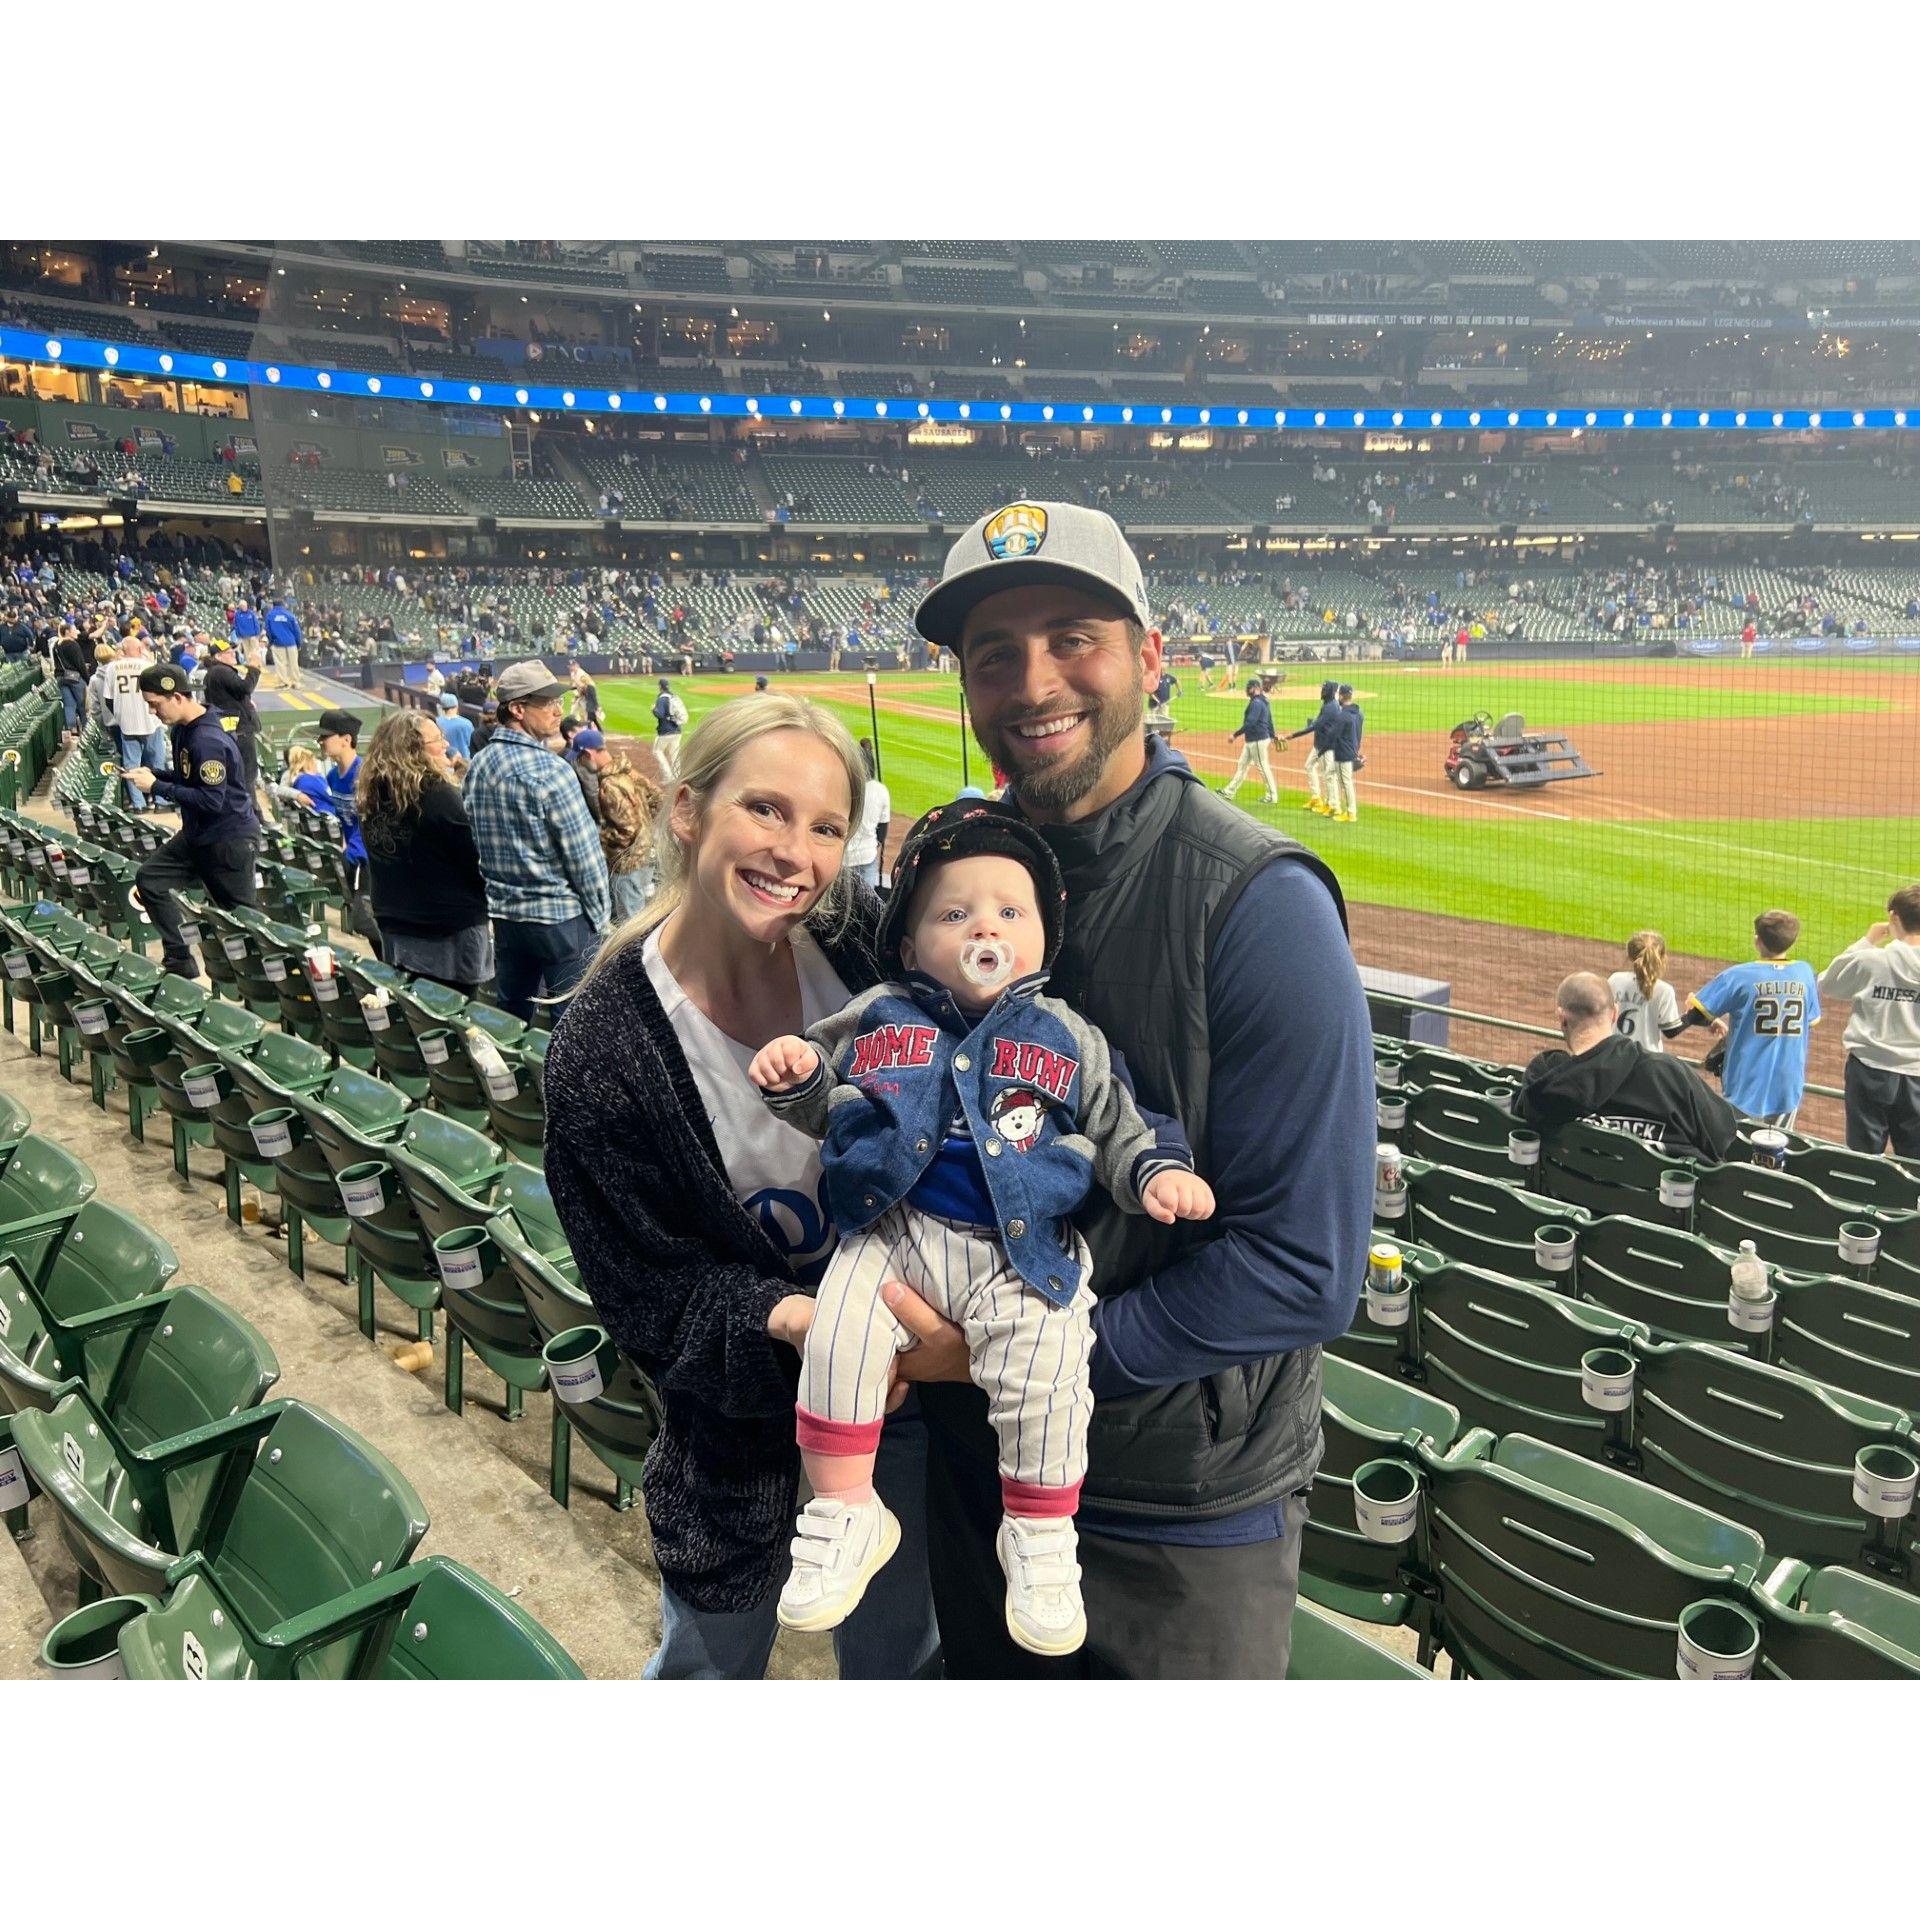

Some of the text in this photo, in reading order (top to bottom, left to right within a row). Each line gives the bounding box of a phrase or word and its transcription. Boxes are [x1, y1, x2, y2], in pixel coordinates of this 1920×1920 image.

[1615, 316, 1673, 326] Northwestern
[1823, 318, 1920, 328] Northwestern Mutua
[923, 428, 967, 437] SAUSAGES
[116, 674, 141, 694] 27
[1754, 980, 1805, 996] YELICH
[1616, 1008, 1639, 1037] 6
[1754, 997, 1805, 1037] 22
[848, 1024, 1079, 1101] HOME RUN!
[67, 1441, 81, 1473] 12
[187, 1643, 203, 1680] 13
